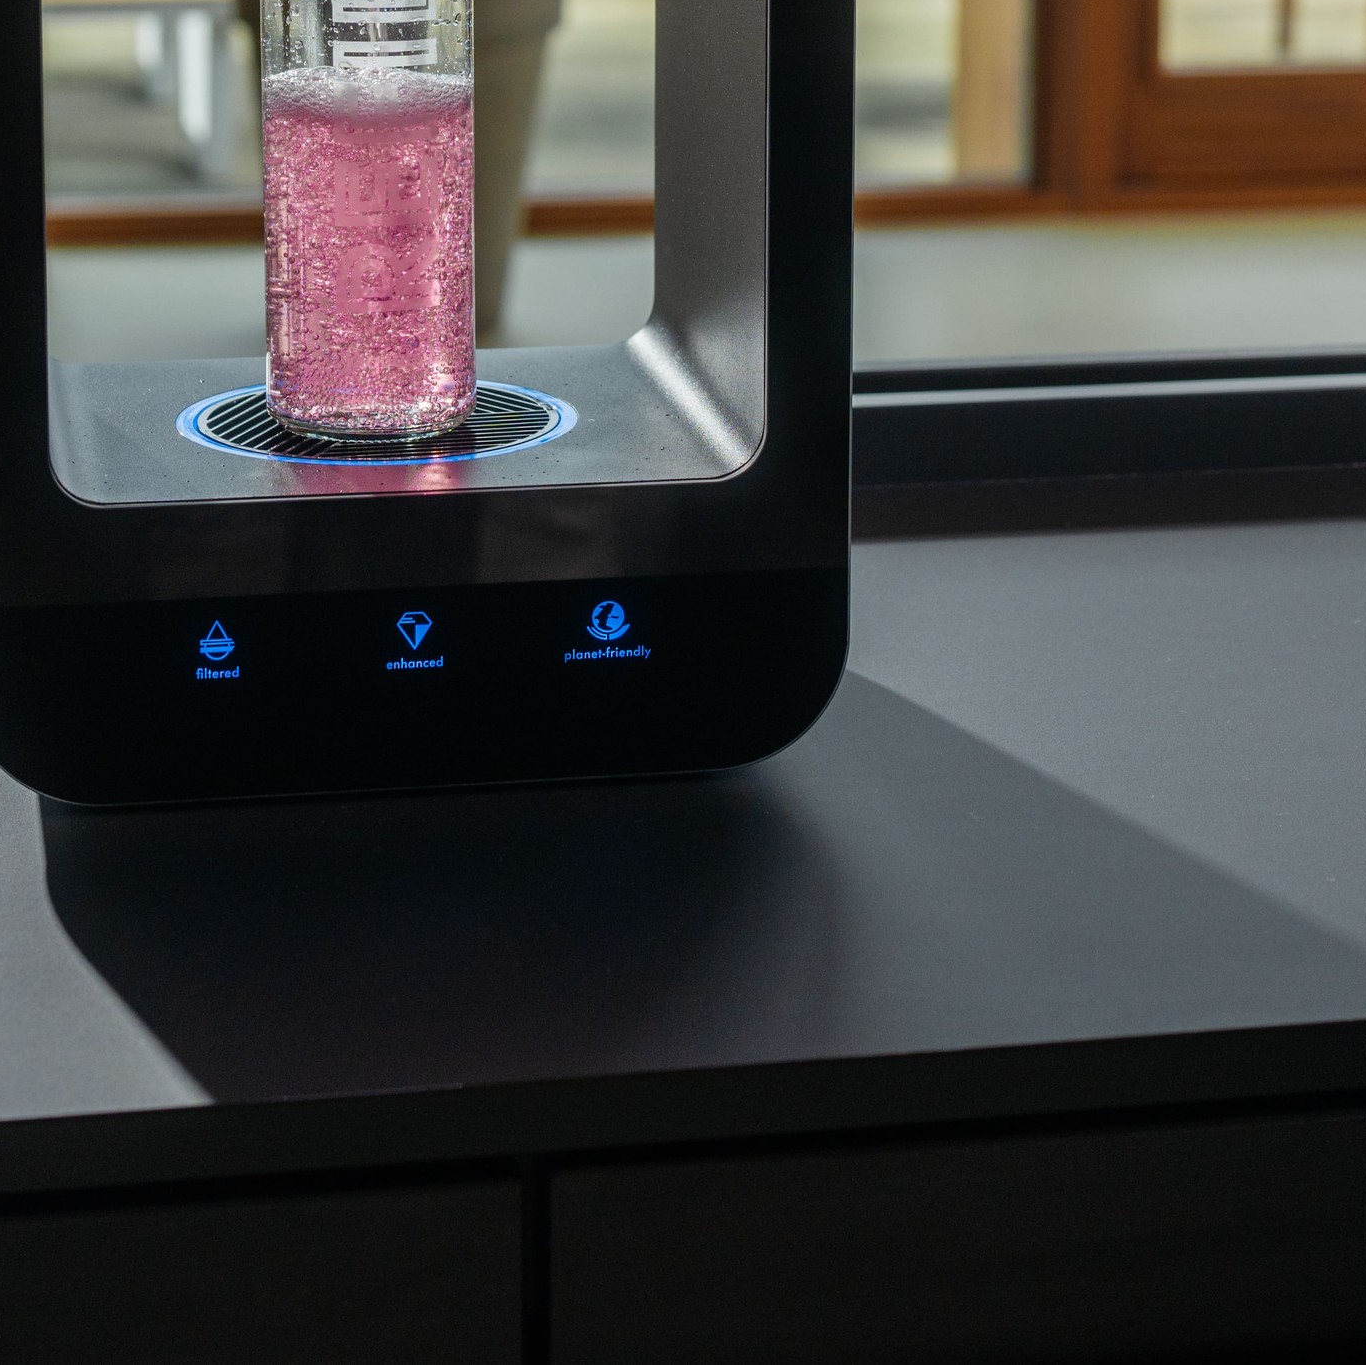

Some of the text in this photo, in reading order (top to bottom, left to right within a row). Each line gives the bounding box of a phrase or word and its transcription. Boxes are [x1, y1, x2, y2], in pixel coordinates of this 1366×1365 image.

[564, 644, 652, 664] planet-friendly
[386, 655, 444, 670] enhanced
[195, 665, 240, 680] filtered
